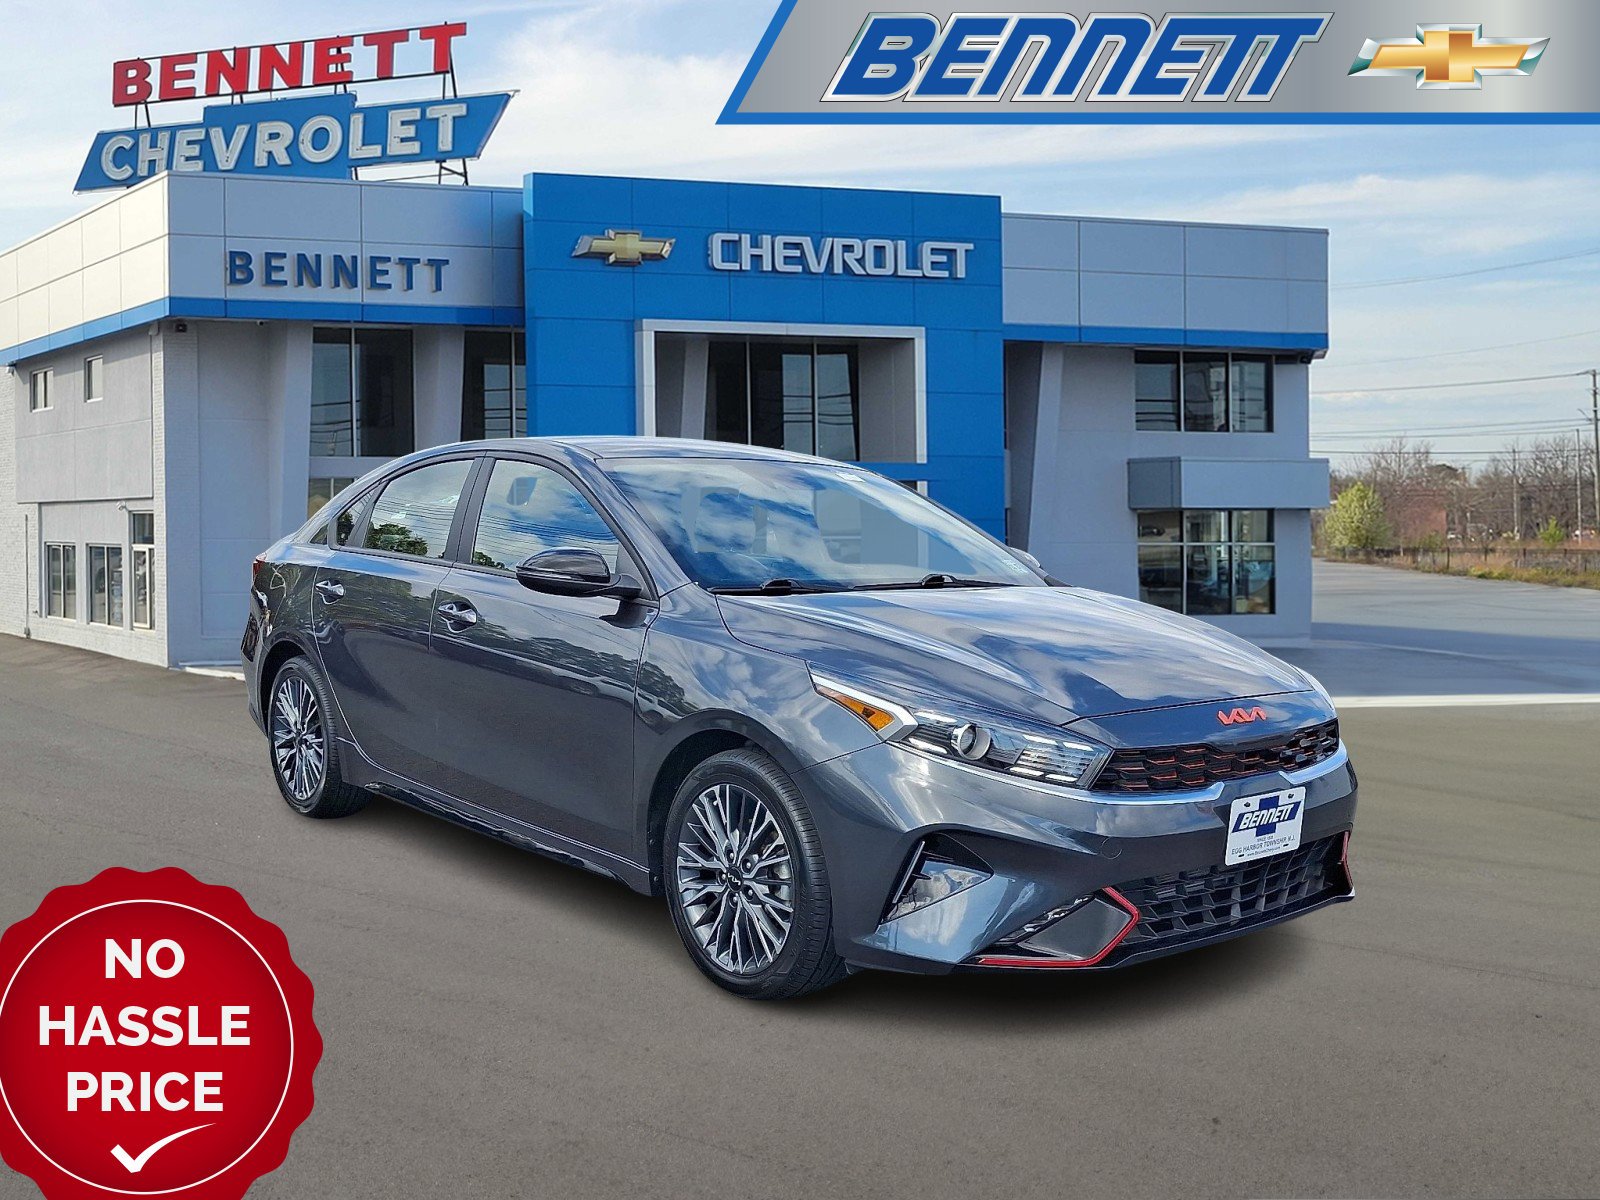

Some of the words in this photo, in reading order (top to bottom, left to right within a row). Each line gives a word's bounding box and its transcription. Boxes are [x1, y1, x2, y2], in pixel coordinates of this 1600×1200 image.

[112, 22, 467, 106] BENNETT
[100, 103, 468, 181] CHEVROLET
[226, 250, 450, 292] BENNETT
[708, 231, 975, 279] CHEVROLET
[1239, 803, 1295, 829] BENNETT
[1231, 847, 1243, 855] EGG
[1243, 842, 1264, 852] HARBOR
